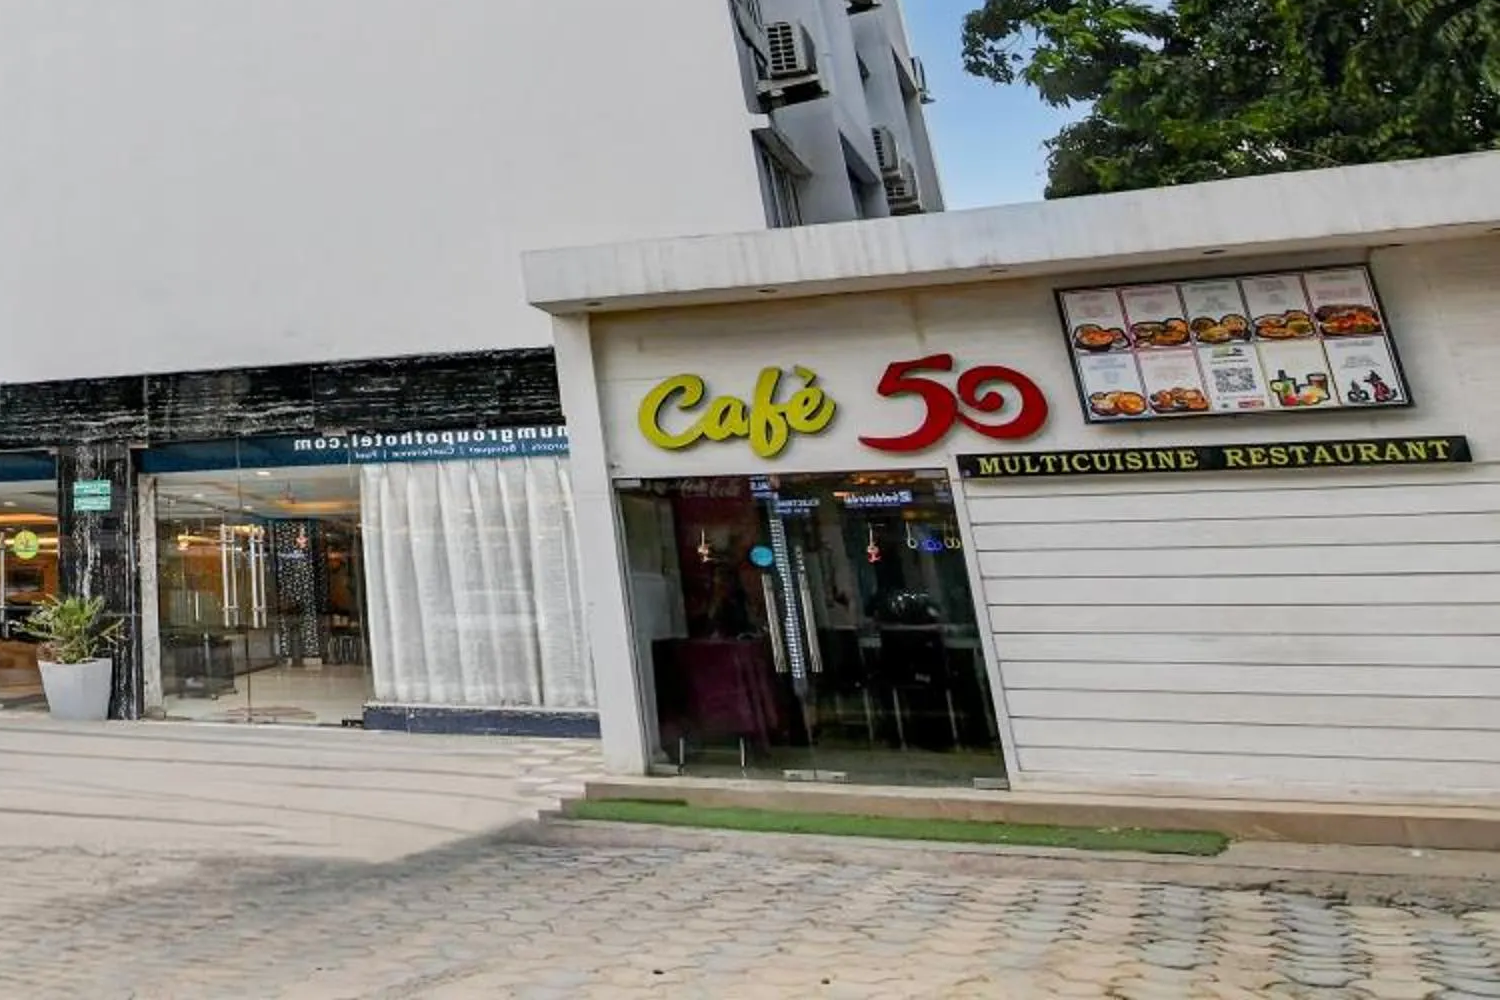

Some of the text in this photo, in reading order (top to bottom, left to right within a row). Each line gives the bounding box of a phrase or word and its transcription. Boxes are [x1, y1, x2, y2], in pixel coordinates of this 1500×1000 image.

[859, 354, 1049, 452] 50
[978, 439, 1451, 476] MULTICUISINE RESTAURANT
